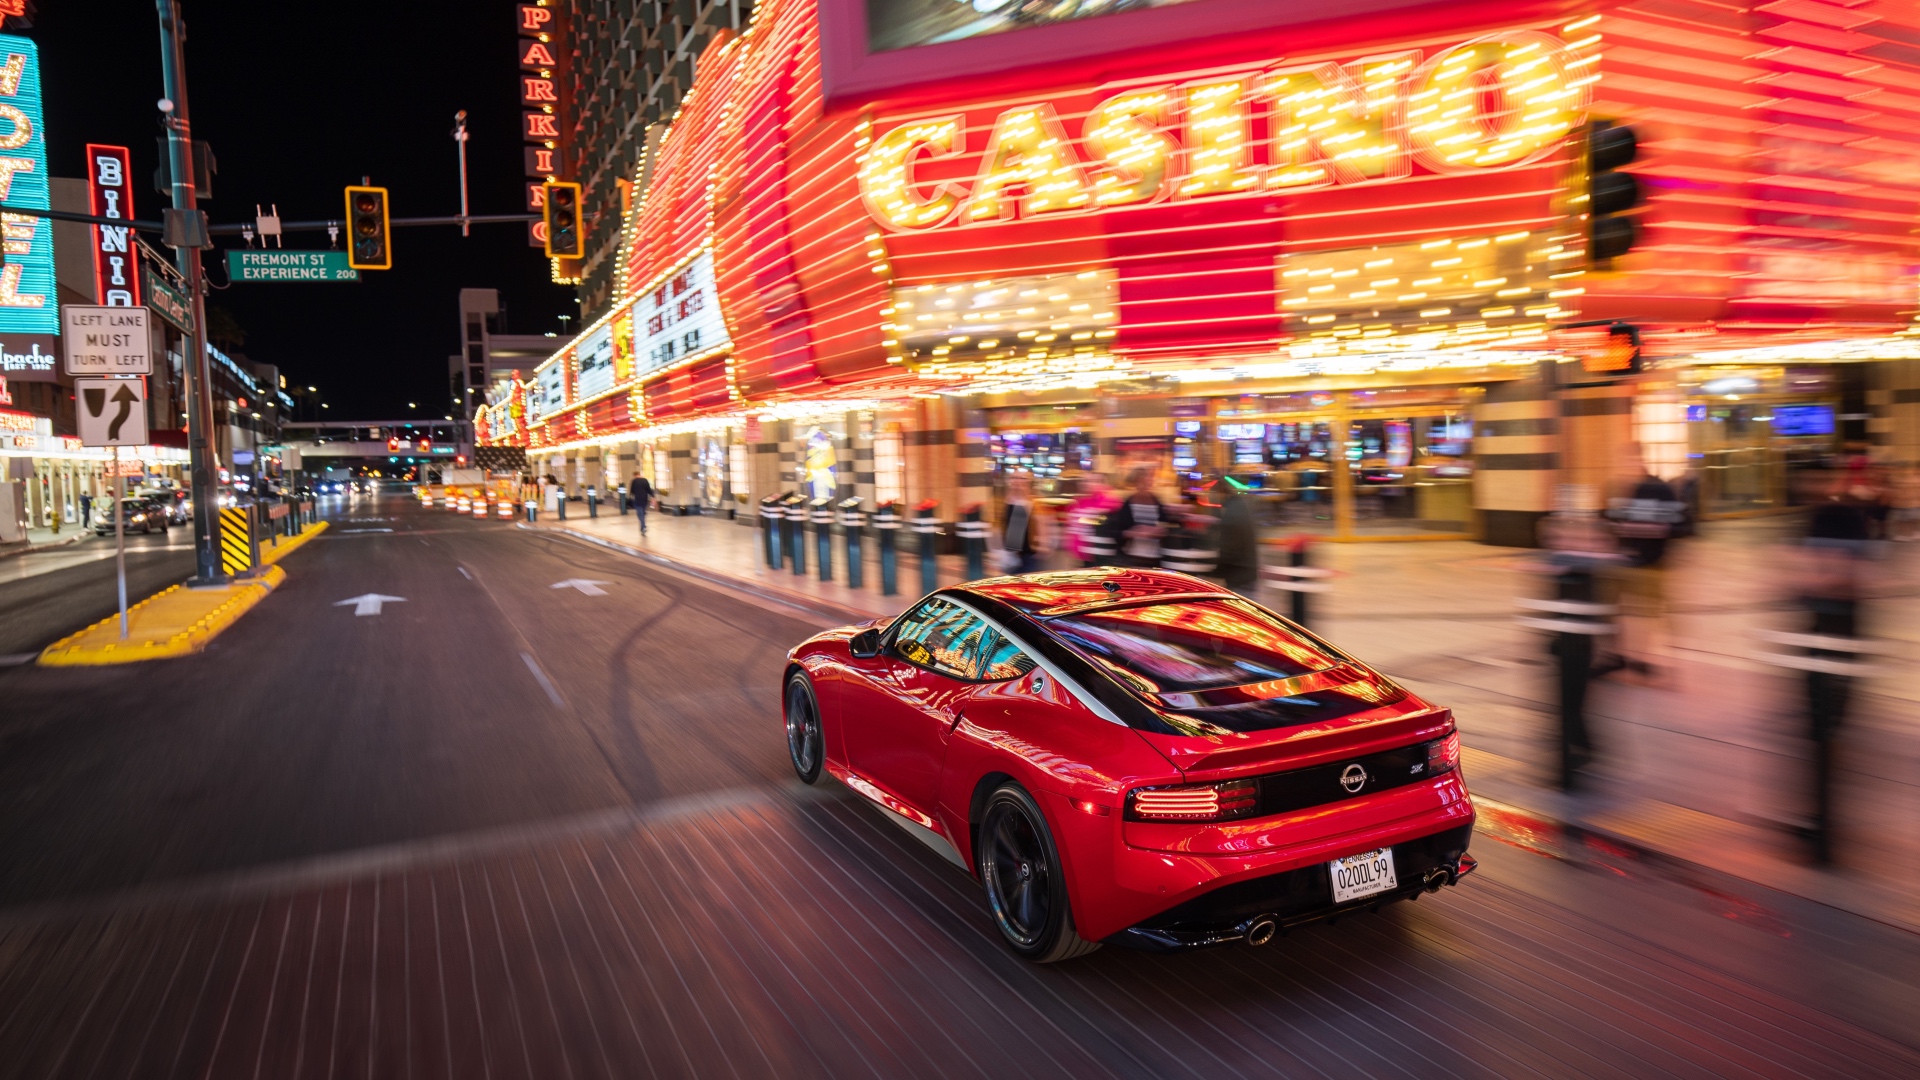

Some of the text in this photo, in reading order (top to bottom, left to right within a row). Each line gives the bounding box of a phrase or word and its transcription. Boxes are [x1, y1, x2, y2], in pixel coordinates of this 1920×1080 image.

[858, 30, 1594, 234] CASINO
[242, 253, 325, 265] FREMONT ST
[243, 267, 356, 279] EXPERIENCE 200
[72, 314, 142, 327] LEFT LANE
[86, 333, 130, 347] MUST
[73, 354, 145, 366] TURN LEFT
[1340, 772, 1367, 785] NISSAN
[1344, 850, 1378, 865] TENNESSEE
[1337, 858, 1388, 889] 020DL99
